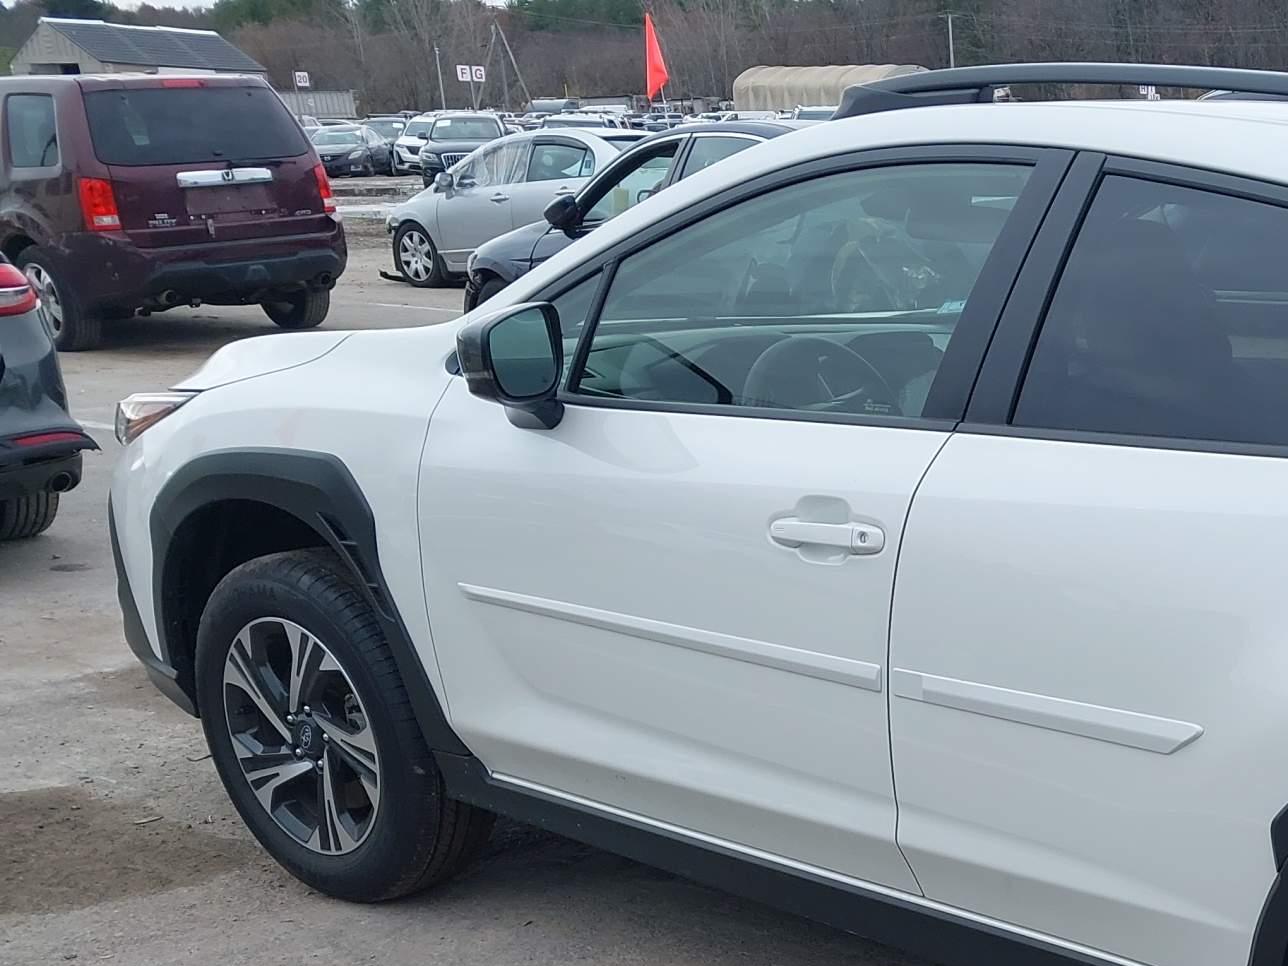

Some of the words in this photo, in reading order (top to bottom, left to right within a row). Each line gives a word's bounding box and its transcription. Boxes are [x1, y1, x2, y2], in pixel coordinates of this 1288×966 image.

[460, 68, 467, 79] F
[474, 68, 483, 80] G
[297, 75, 308, 84] 20
